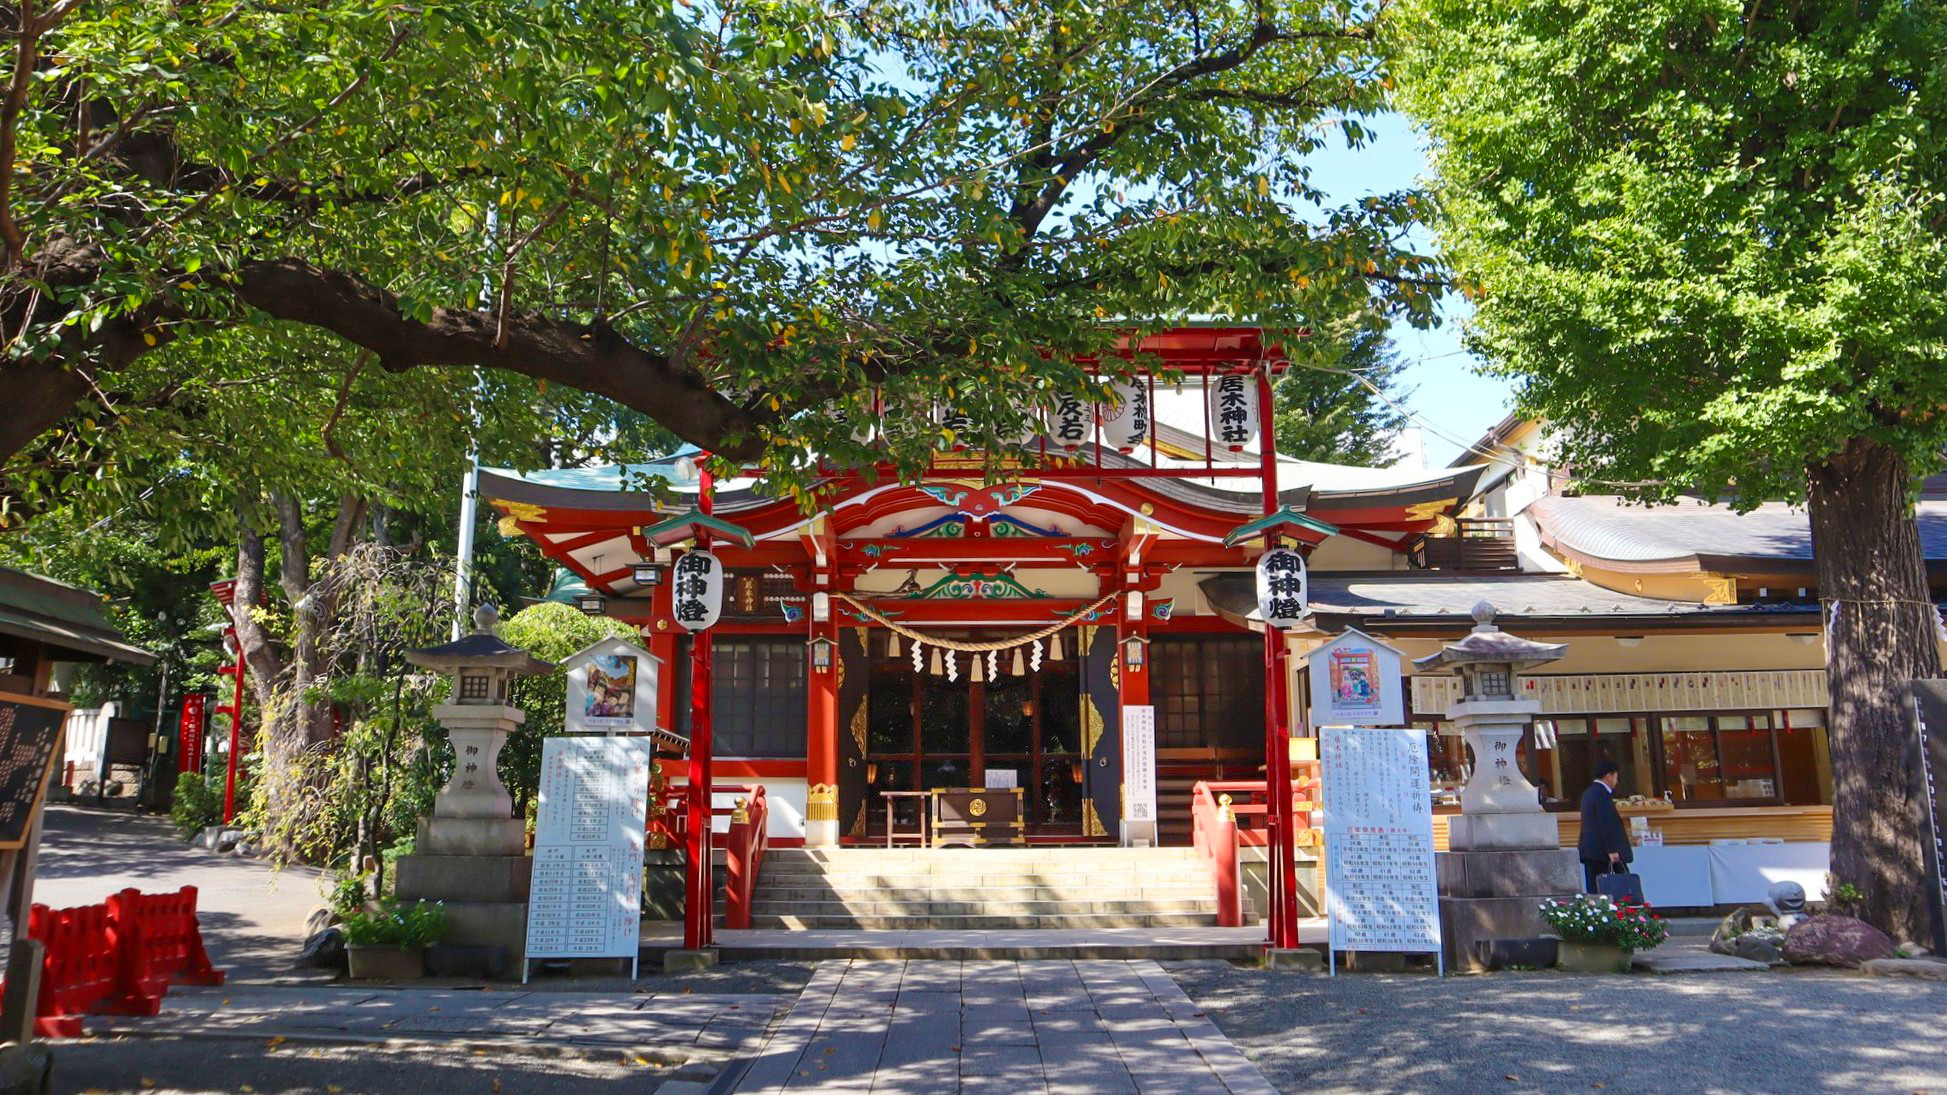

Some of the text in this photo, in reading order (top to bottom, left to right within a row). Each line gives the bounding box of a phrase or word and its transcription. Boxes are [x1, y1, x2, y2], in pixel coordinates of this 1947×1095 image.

[1218, 375, 1248, 442] 居木神社
[676, 552, 712, 622] 御神燈
[1266, 551, 1302, 620] 御神燈
